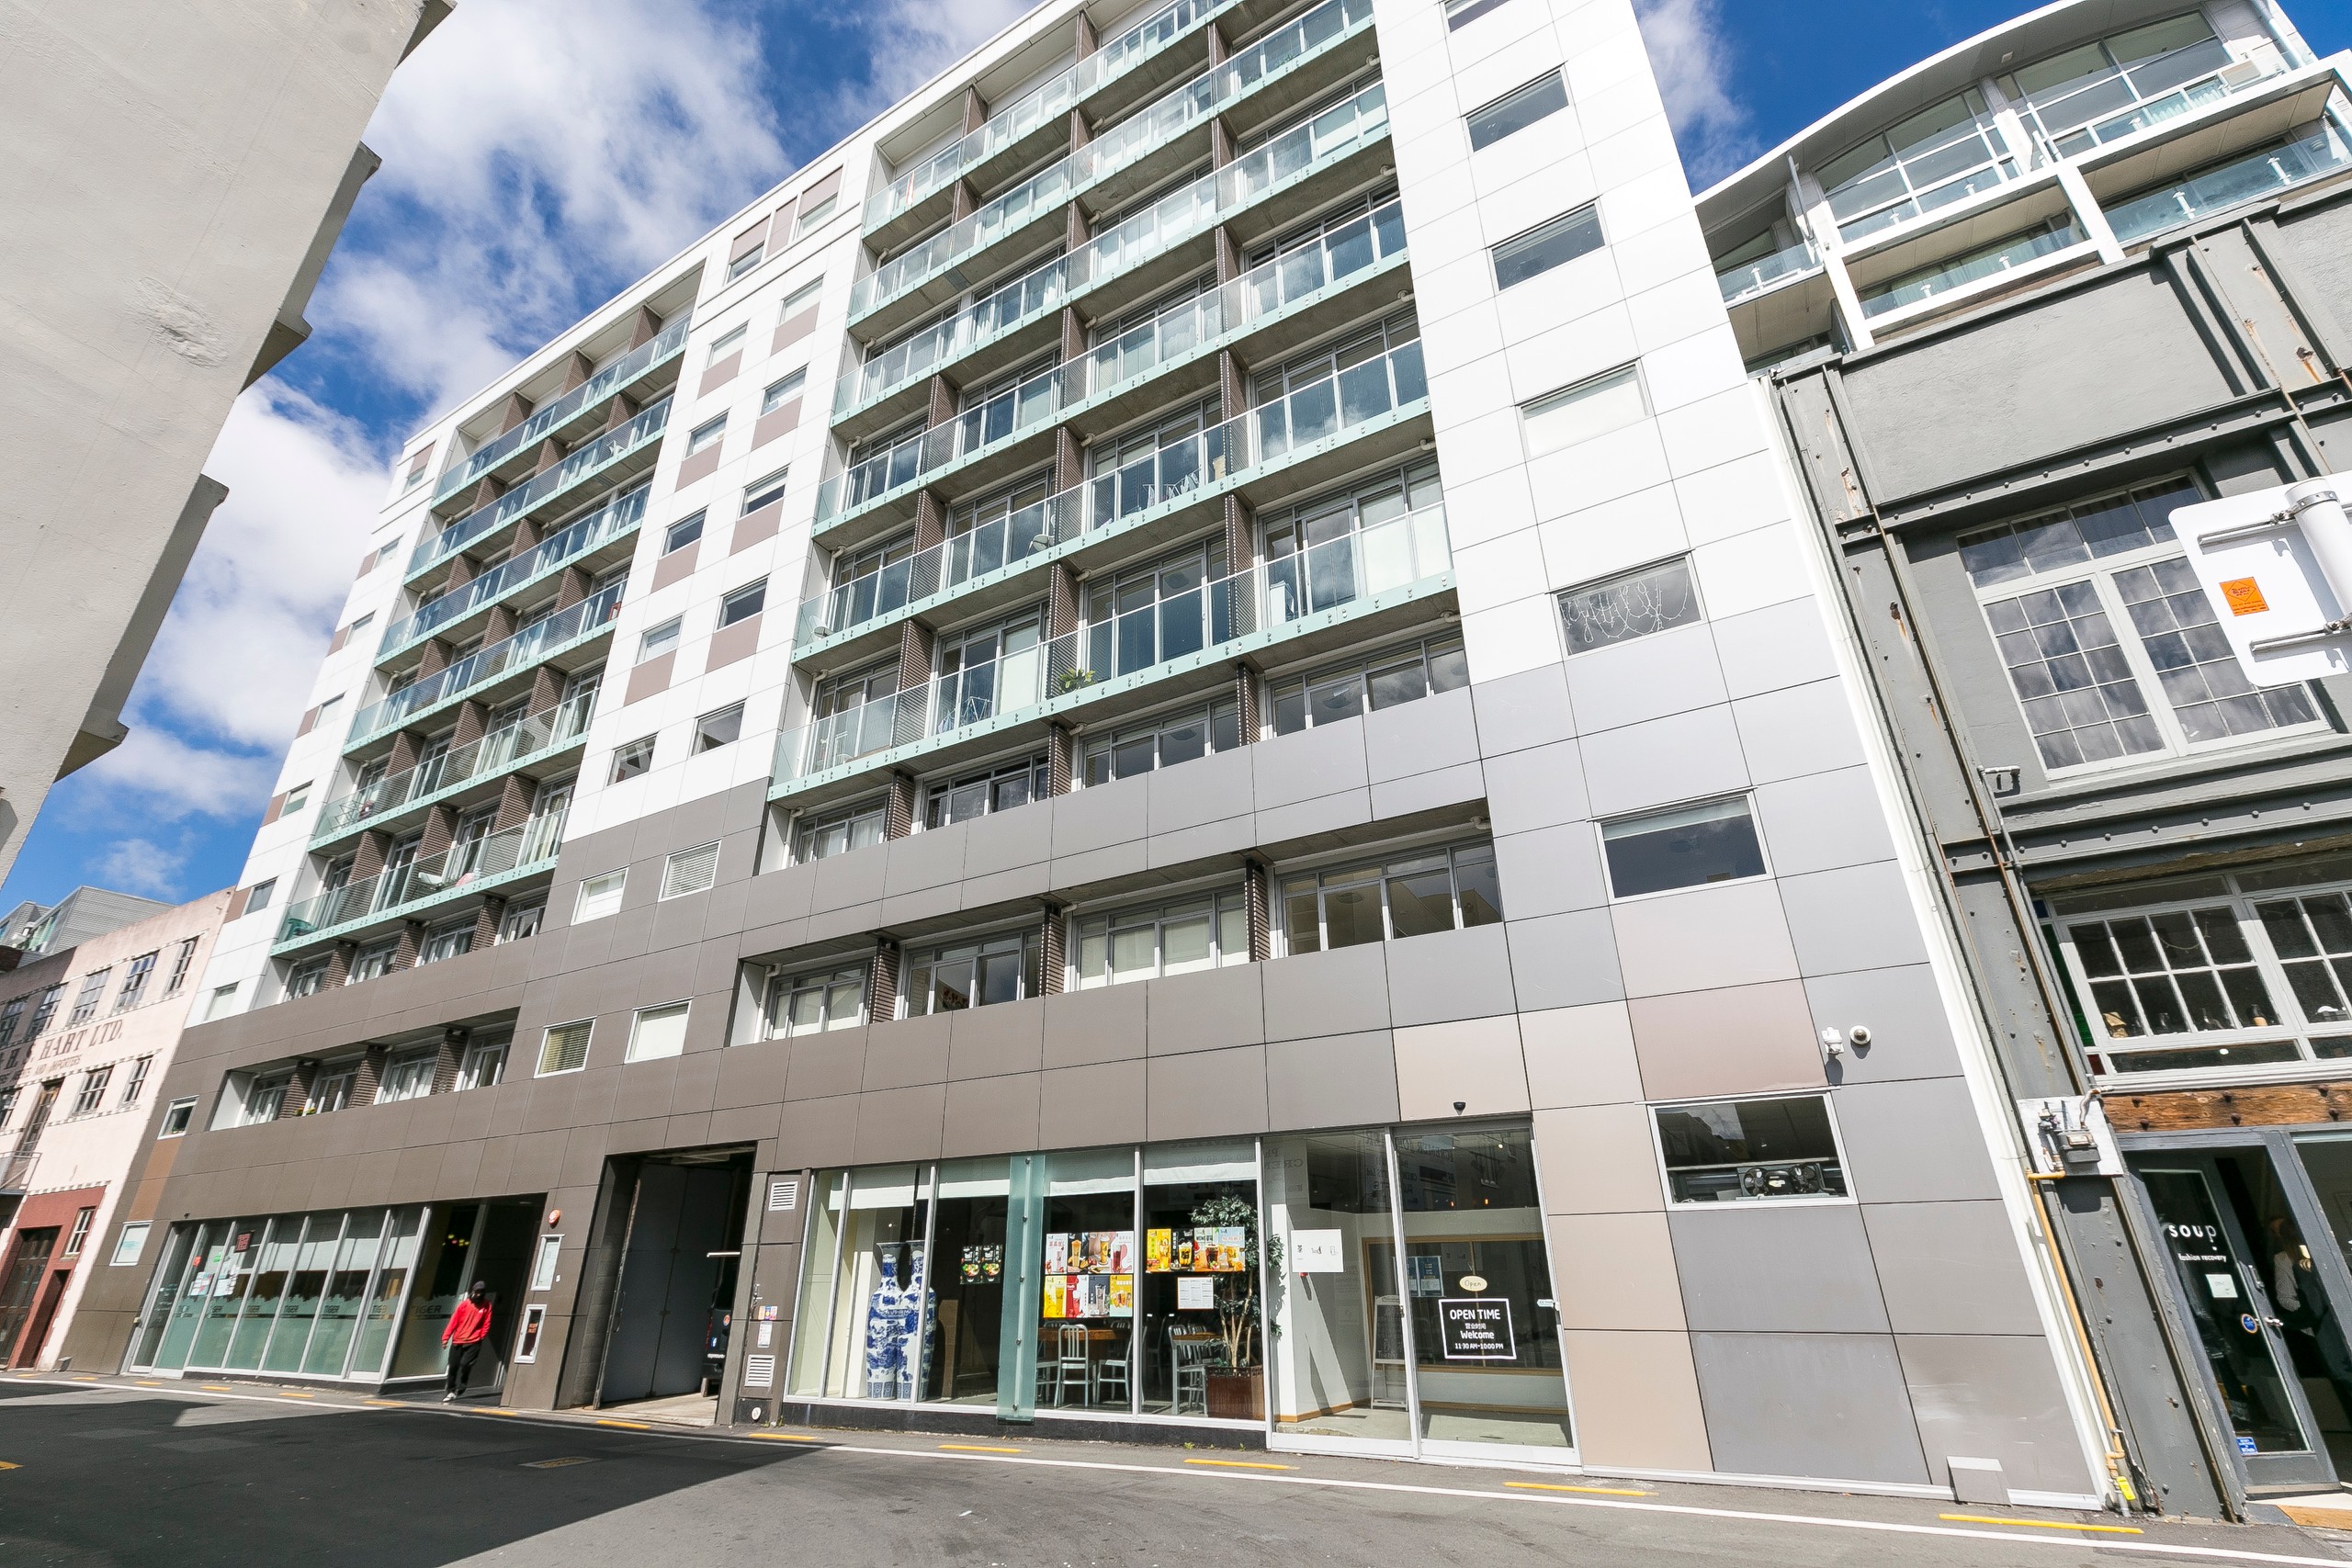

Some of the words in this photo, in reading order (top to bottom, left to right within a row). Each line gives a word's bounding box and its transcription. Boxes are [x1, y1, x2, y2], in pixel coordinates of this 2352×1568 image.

[38, 1029, 88, 1060] HART
[2177, 1252, 2201, 1261] fashion
[2200, 1254, 2227, 1263] recovery
[1464, 1276, 1482, 1288] Open
[1450, 1309, 1476, 1320] OPEN
[1476, 1309, 1501, 1320] TIME
[1460, 1330, 1495, 1339] Welcome
